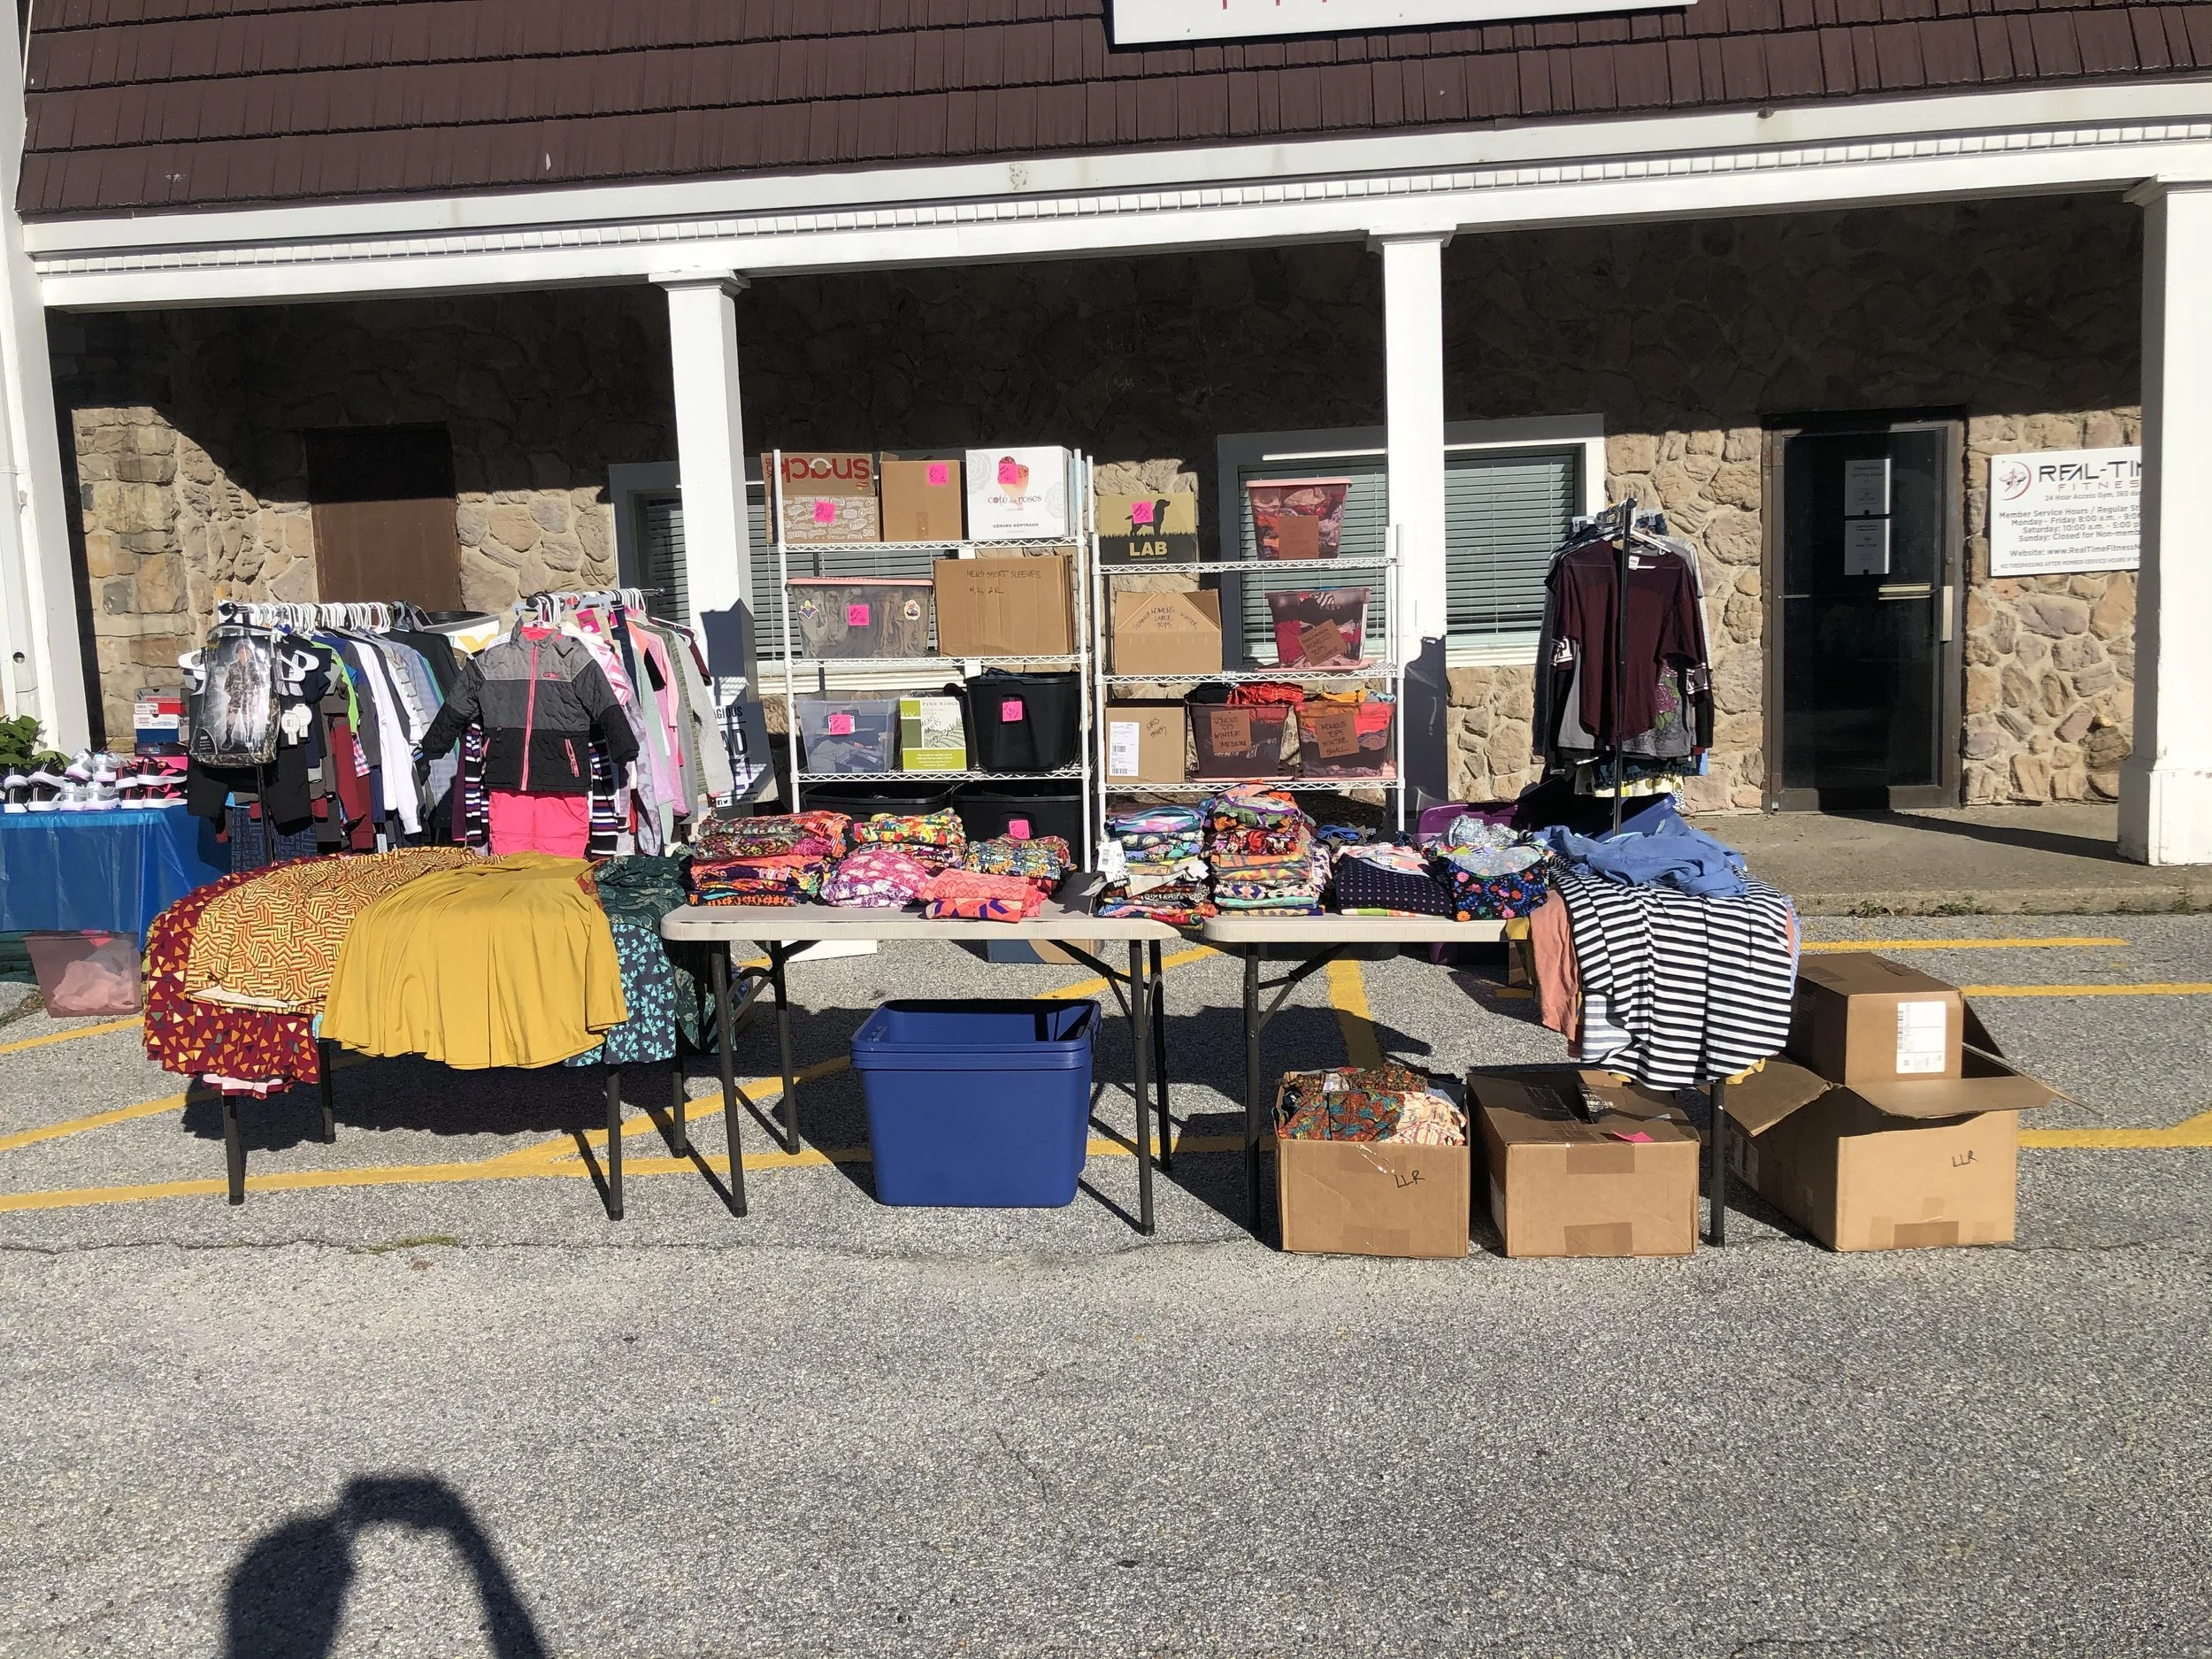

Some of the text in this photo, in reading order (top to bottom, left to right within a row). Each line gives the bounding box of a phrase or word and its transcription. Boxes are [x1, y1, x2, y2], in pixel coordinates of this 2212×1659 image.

[2073, 492, 2096, 501] Access
[2097, 491, 2115, 500] Gym,
[1999, 511, 2032, 519] Member
[2033, 509, 2062, 518] Service
[2065, 507, 2088, 516] Hours
[2097, 505, 2128, 515] Regular
[2011, 518, 2042, 527] Monday
[2050, 516, 2076, 526] Friday
[2023, 525, 2061, 534] Saturday:
[2018, 534, 2051, 542] Sunday:
[1129, 541, 1168, 557] LAB
[2009, 549, 2046, 557] Website:
[987, 570, 1009, 579] SHORT
[1010, 570, 1041, 580] SLEEVES
[715, 705, 743, 719] GIOUS
[1213, 731, 1240, 740] WINTER
[1951, 1149, 1979, 1168] LLR
[1394, 1170, 1425, 1189] LLR
